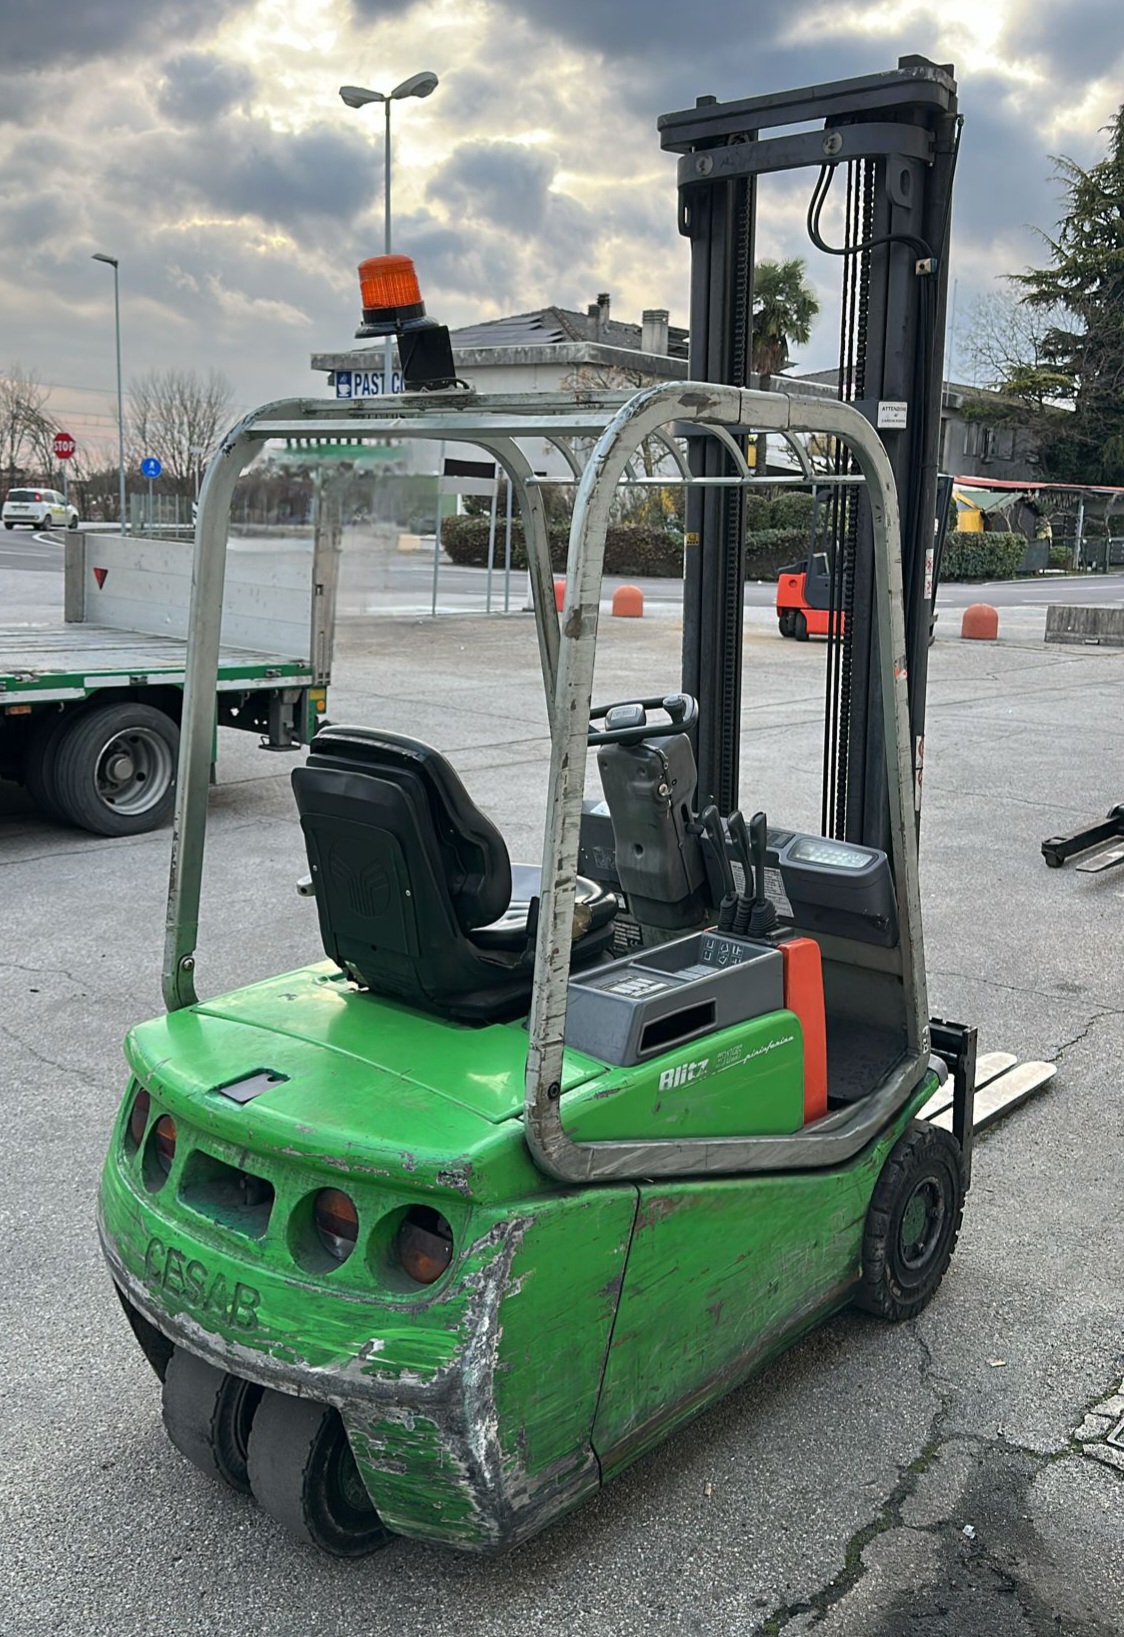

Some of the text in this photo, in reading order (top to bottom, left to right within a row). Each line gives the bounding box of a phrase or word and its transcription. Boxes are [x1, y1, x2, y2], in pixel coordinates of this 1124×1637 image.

[354, 372, 405, 395] PASTC
[54, 440, 76, 452] STOP
[658, 1058, 710, 1091] Blitz
[145, 1237, 261, 1332] CESAB
